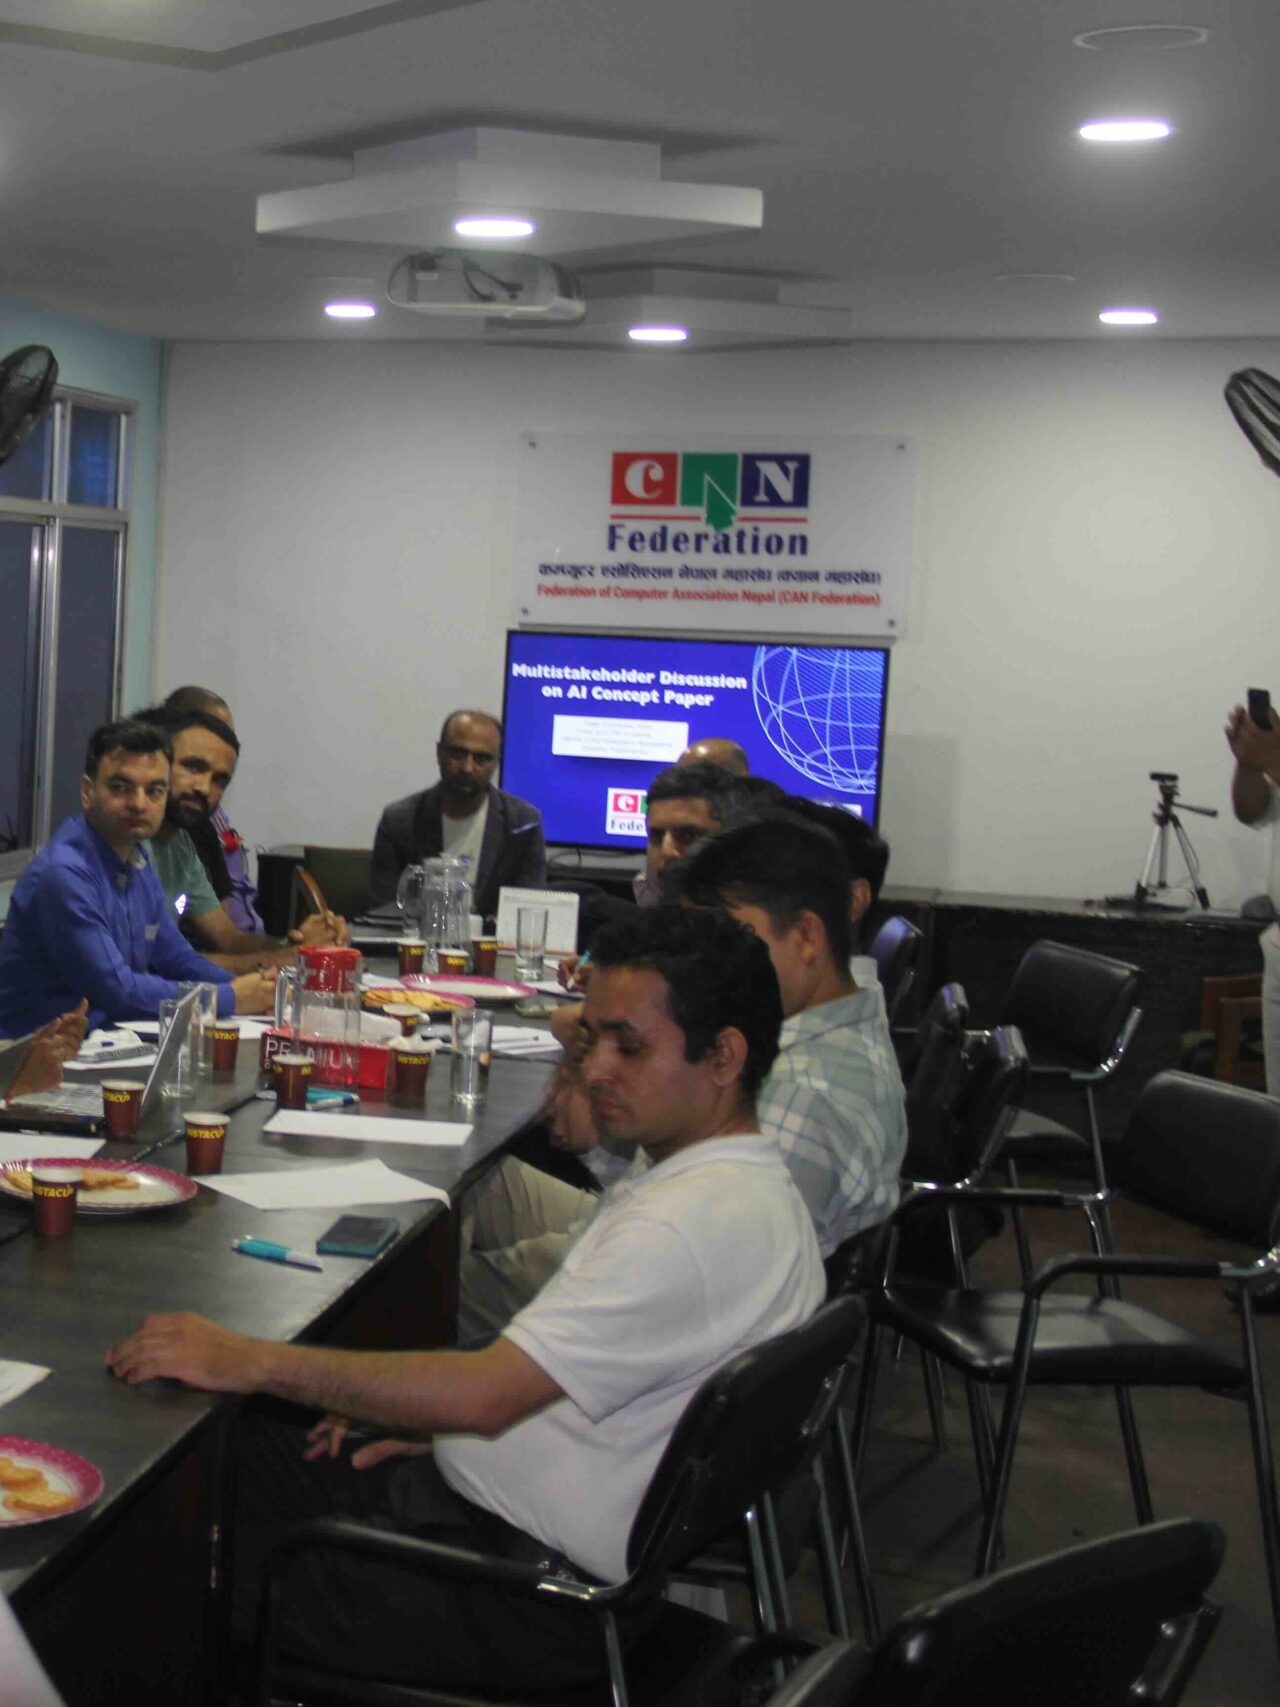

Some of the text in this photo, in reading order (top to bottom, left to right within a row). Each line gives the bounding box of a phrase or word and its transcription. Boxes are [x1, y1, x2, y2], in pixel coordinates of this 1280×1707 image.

[607, 523, 809, 556] Federation
[536, 582, 596, 598] Federation
[600, 584, 612, 598] of
[613, 584, 669, 602] Computer
[742, 588, 775, 606] Nepal
[511, 662, 748, 690] Multistakeholder Discussion
[541, 685, 715, 710] on AI Concept Paper
